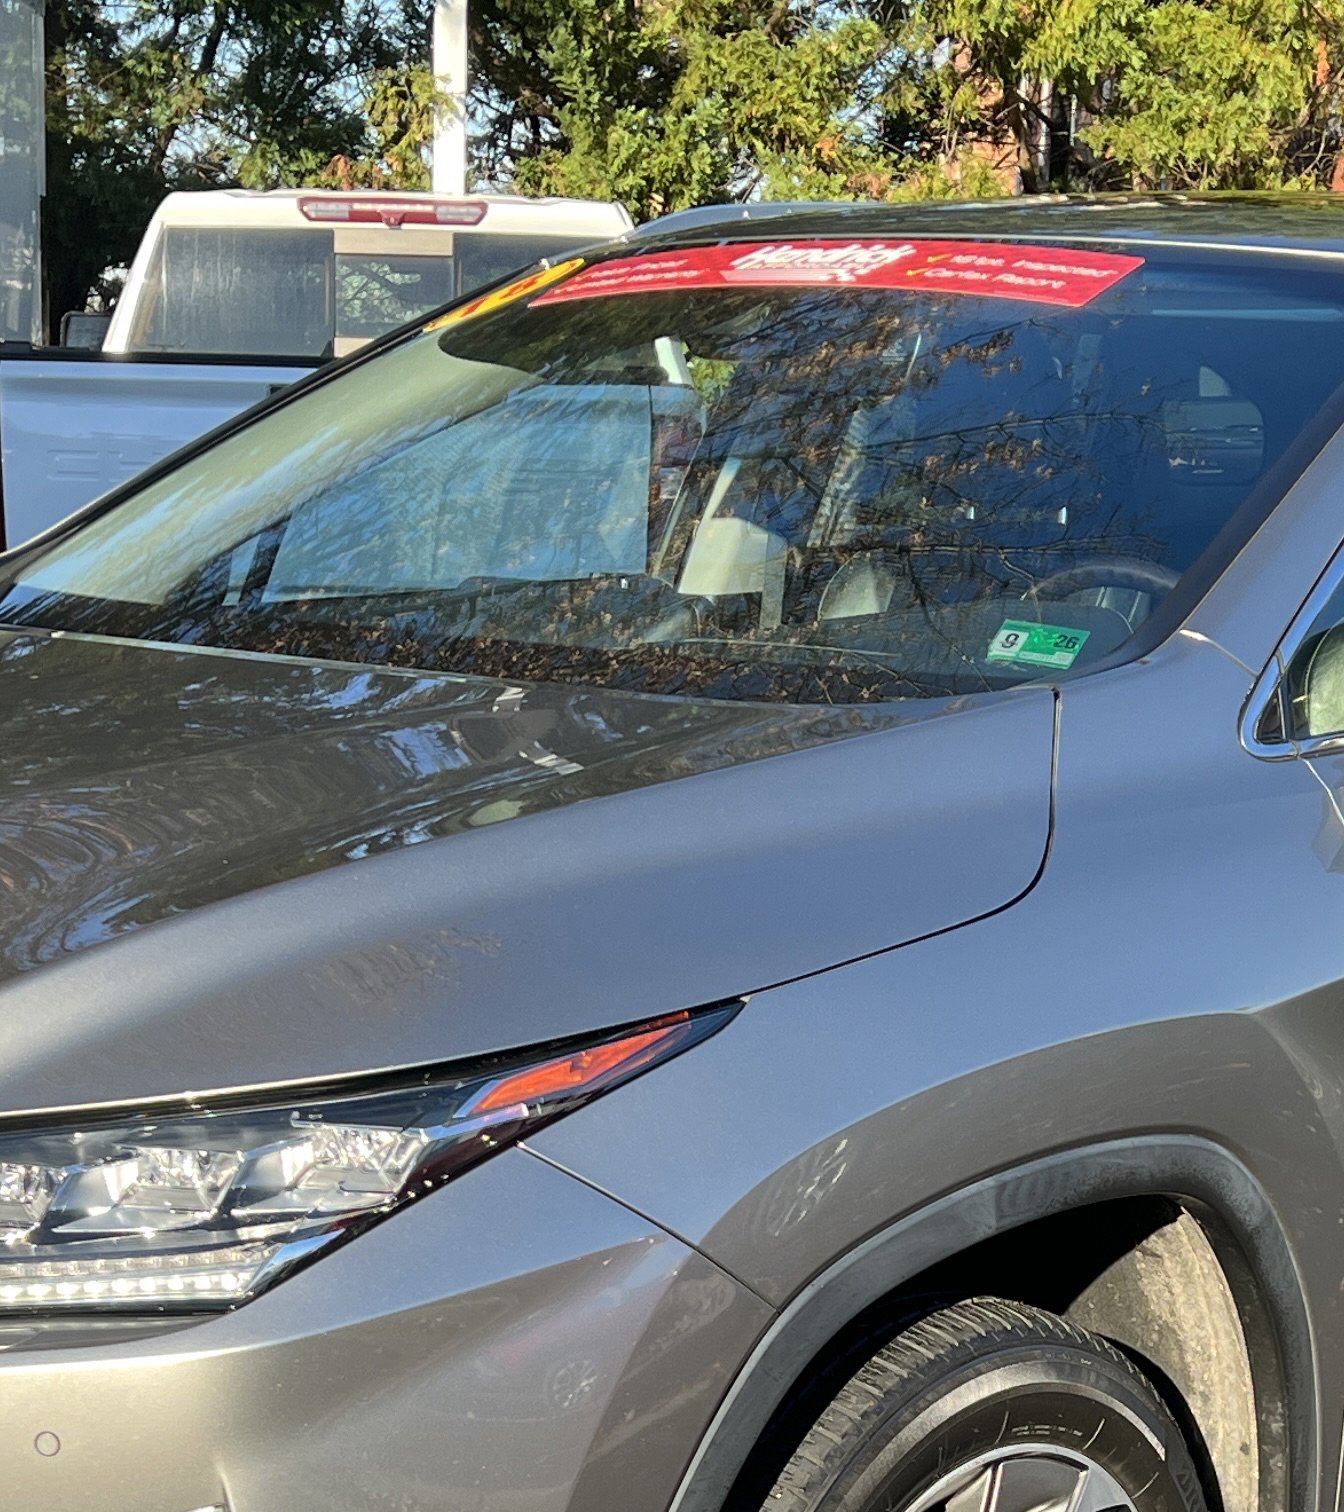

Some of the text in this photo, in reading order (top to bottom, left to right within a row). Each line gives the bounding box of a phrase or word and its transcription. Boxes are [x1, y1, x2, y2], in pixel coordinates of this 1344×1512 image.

[729, 244, 917, 275] Hendrick
[1001, 633, 1080, 649] 9 26
